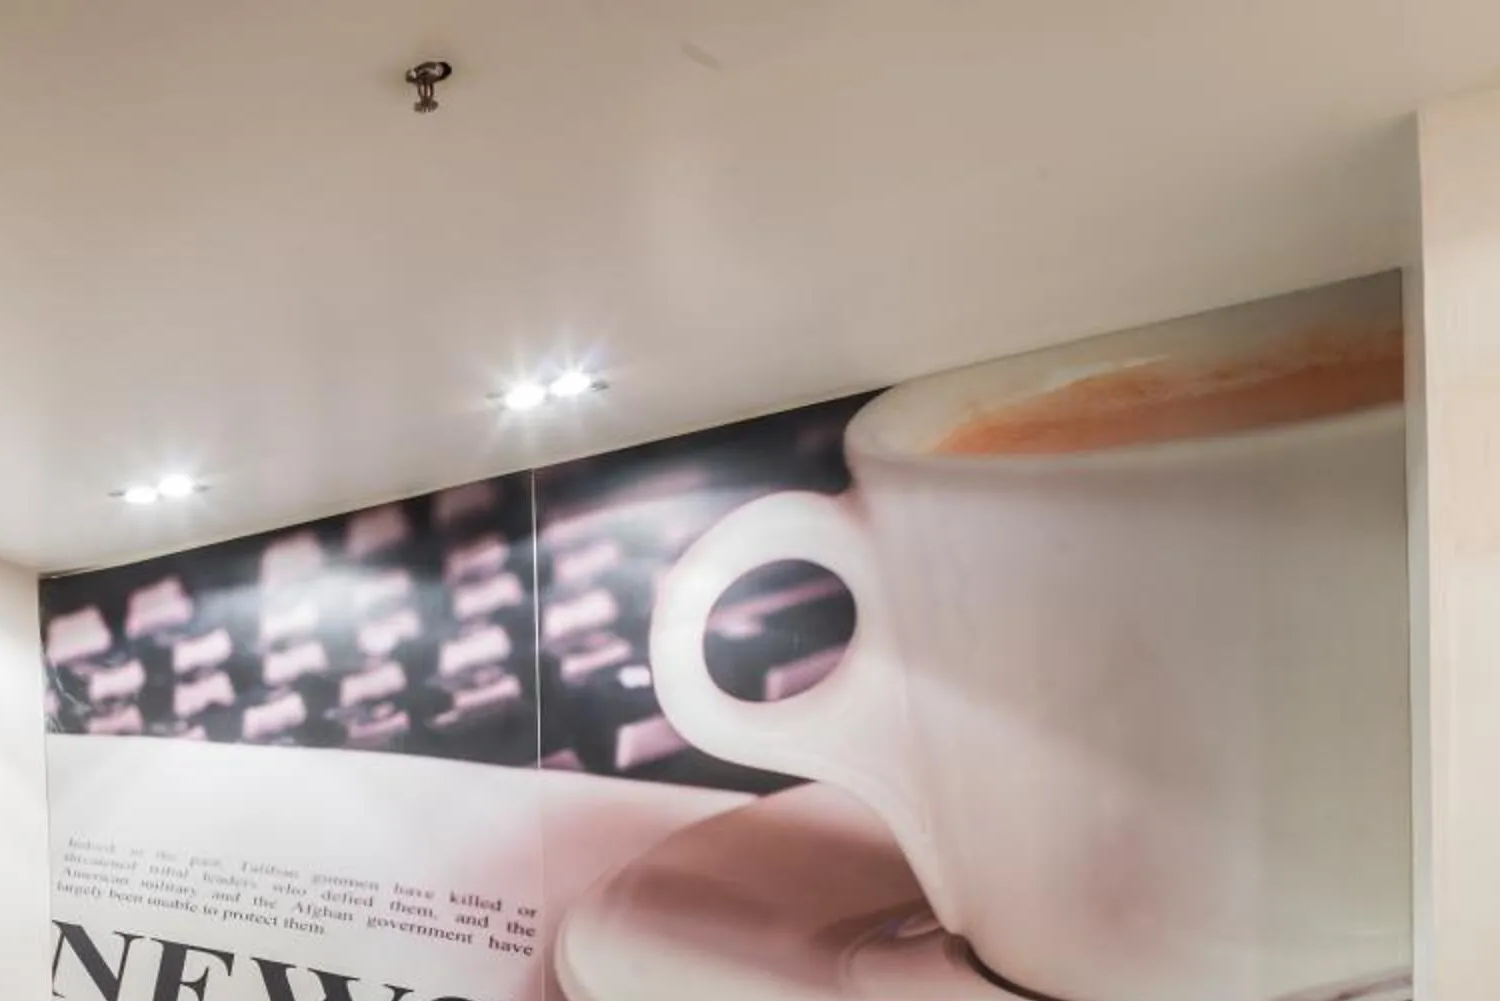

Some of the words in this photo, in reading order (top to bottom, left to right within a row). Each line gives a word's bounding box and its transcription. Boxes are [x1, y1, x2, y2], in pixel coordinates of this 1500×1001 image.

[109, 888, 144, 904] been
[147, 897, 199, 913] unable
[202, 904, 219, 916] to
[223, 909, 279, 927] protect
[283, 917, 326, 935] them
[211, 891, 242, 903] and
[253, 895, 278, 910] the
[293, 901, 354, 922] Afghan
[366, 914, 473, 945] government
[488, 935, 534, 957] have
[272, 883, 308, 897] who
[321, 890, 374, 908] defied
[455, 913, 490, 928] and
[506, 921, 536, 938] the
[394, 882, 435, 899] have
[449, 890, 503, 912] killed
[517, 906, 538, 918] or
